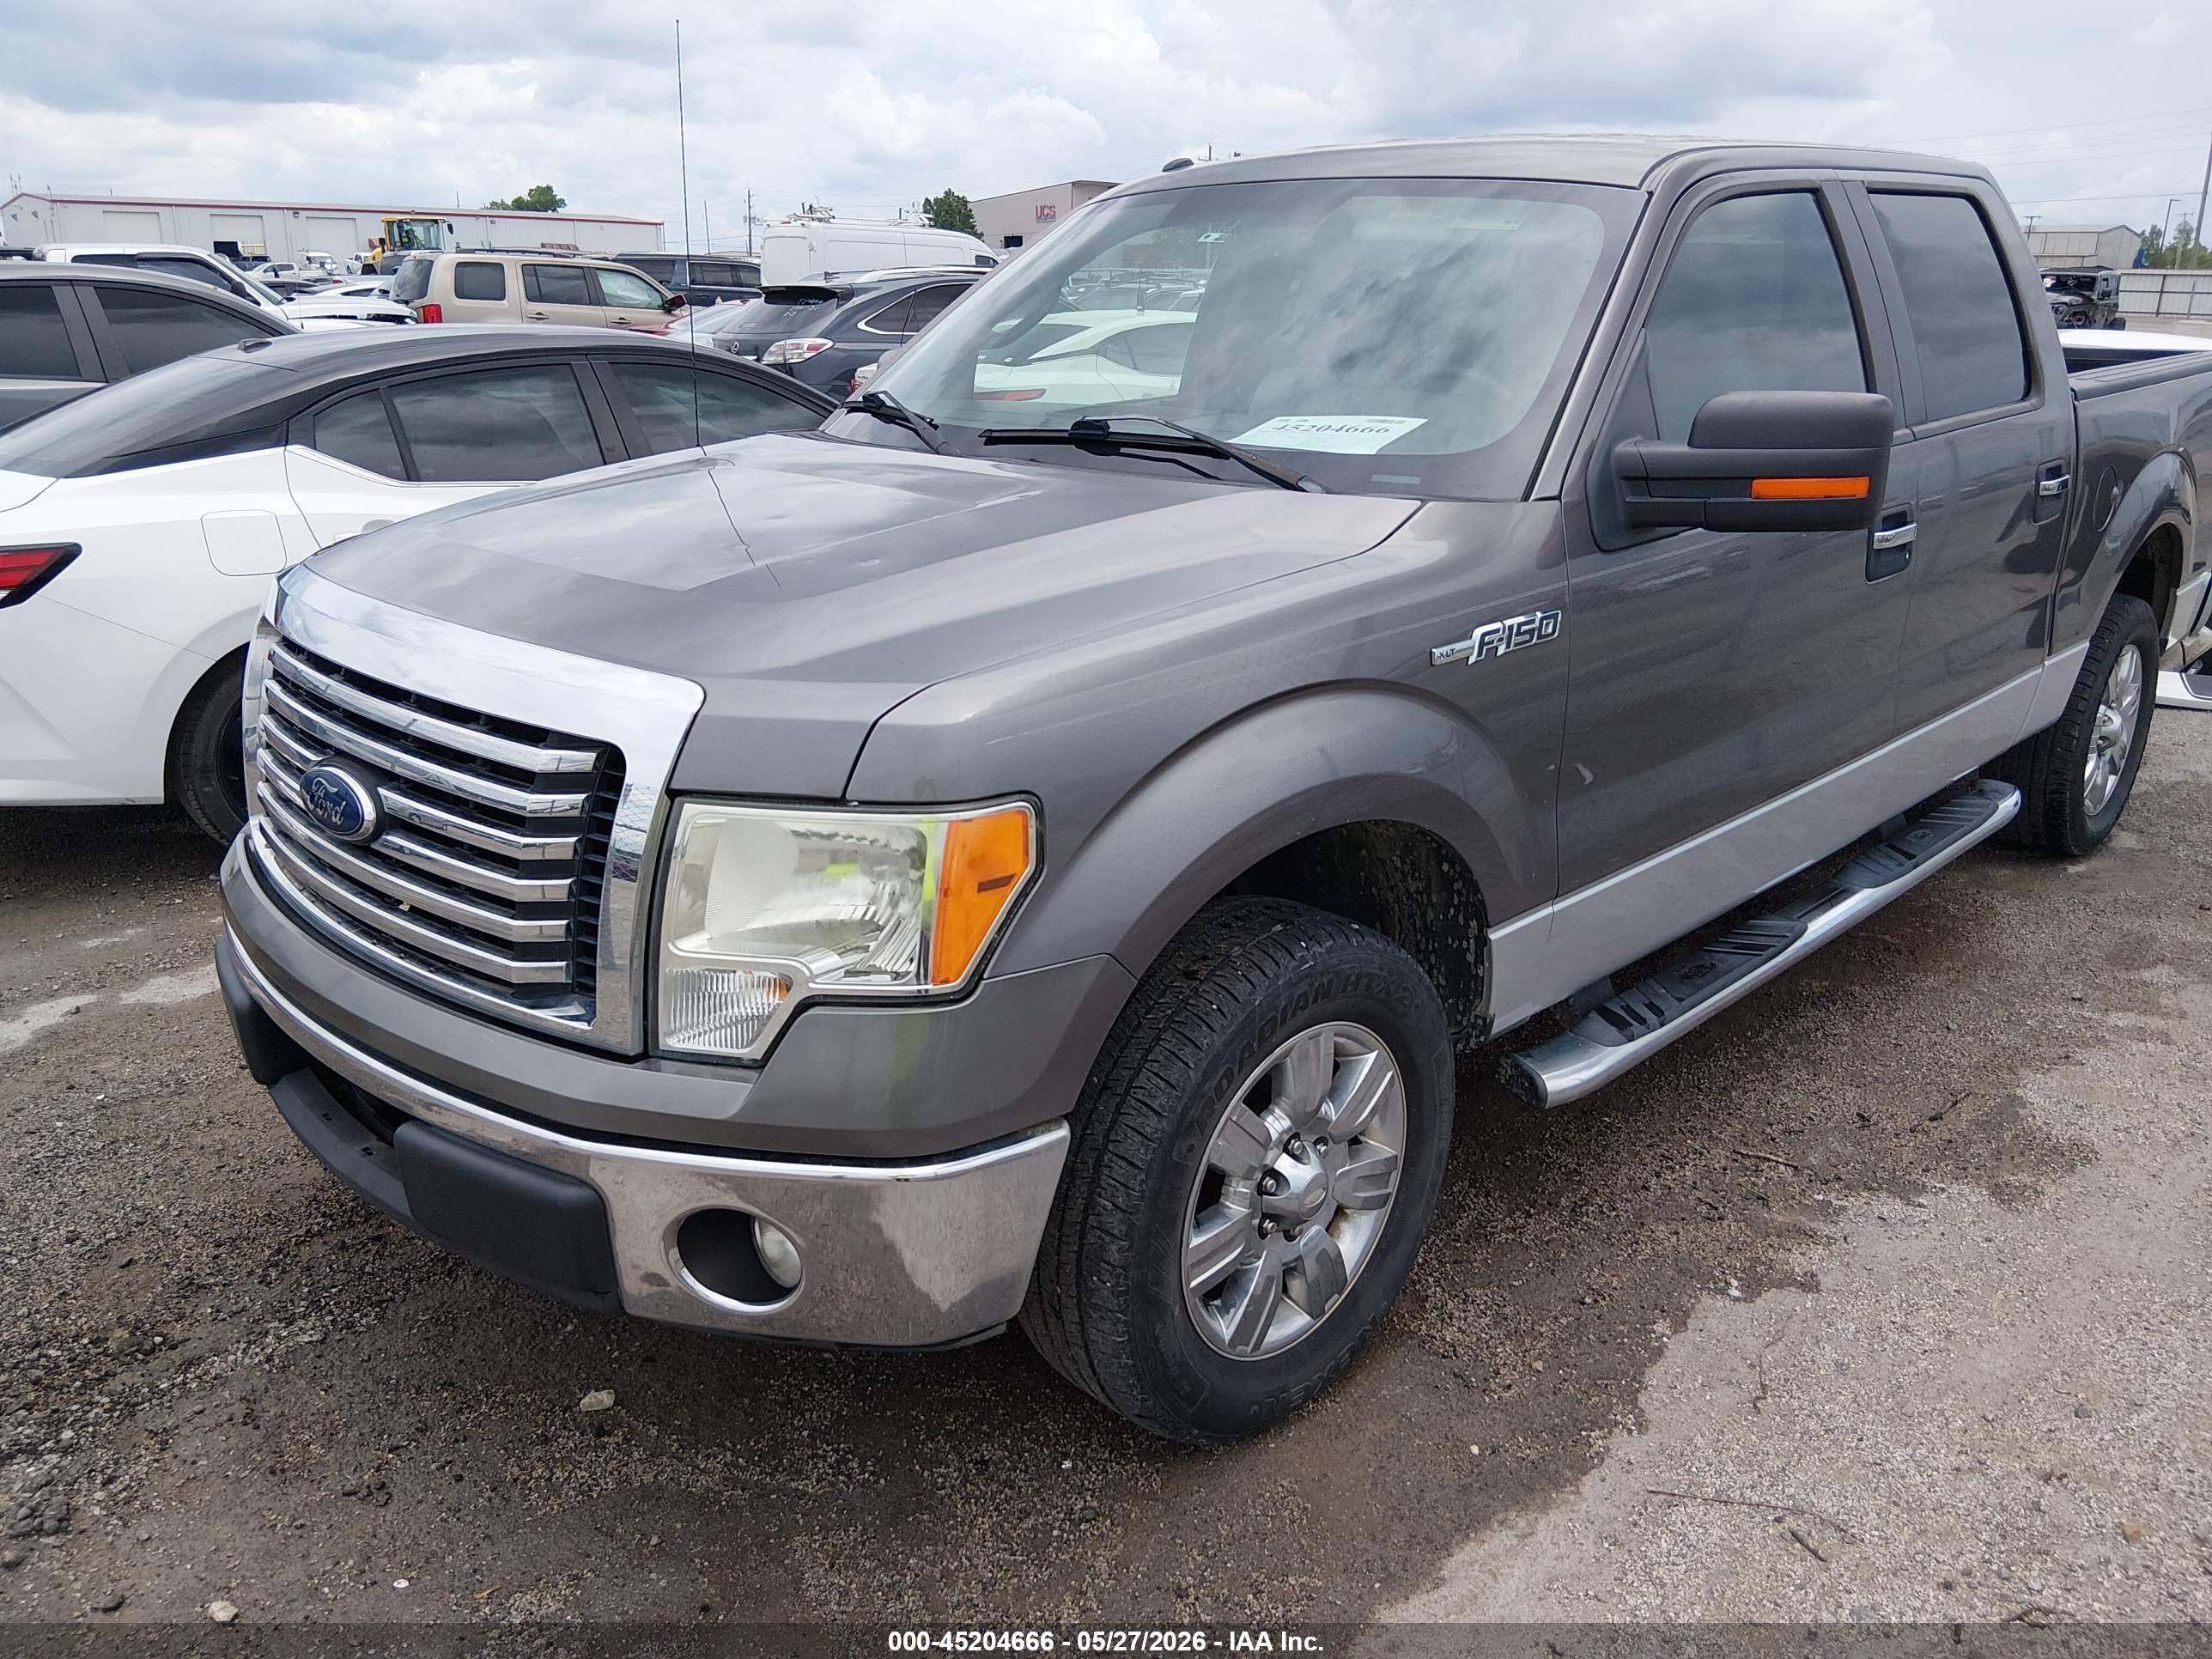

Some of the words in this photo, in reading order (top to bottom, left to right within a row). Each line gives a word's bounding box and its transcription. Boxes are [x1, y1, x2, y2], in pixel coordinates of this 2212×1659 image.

[1036, 205, 1056, 218] UCS
[1272, 424, 1391, 434] 45204666
[1437, 647, 1456, 659] XLT
[307, 777, 347, 825] Ford
[1196, 974, 1334, 1137] ROADIAN
[1264, 1312, 1378, 1417] NEXEN
